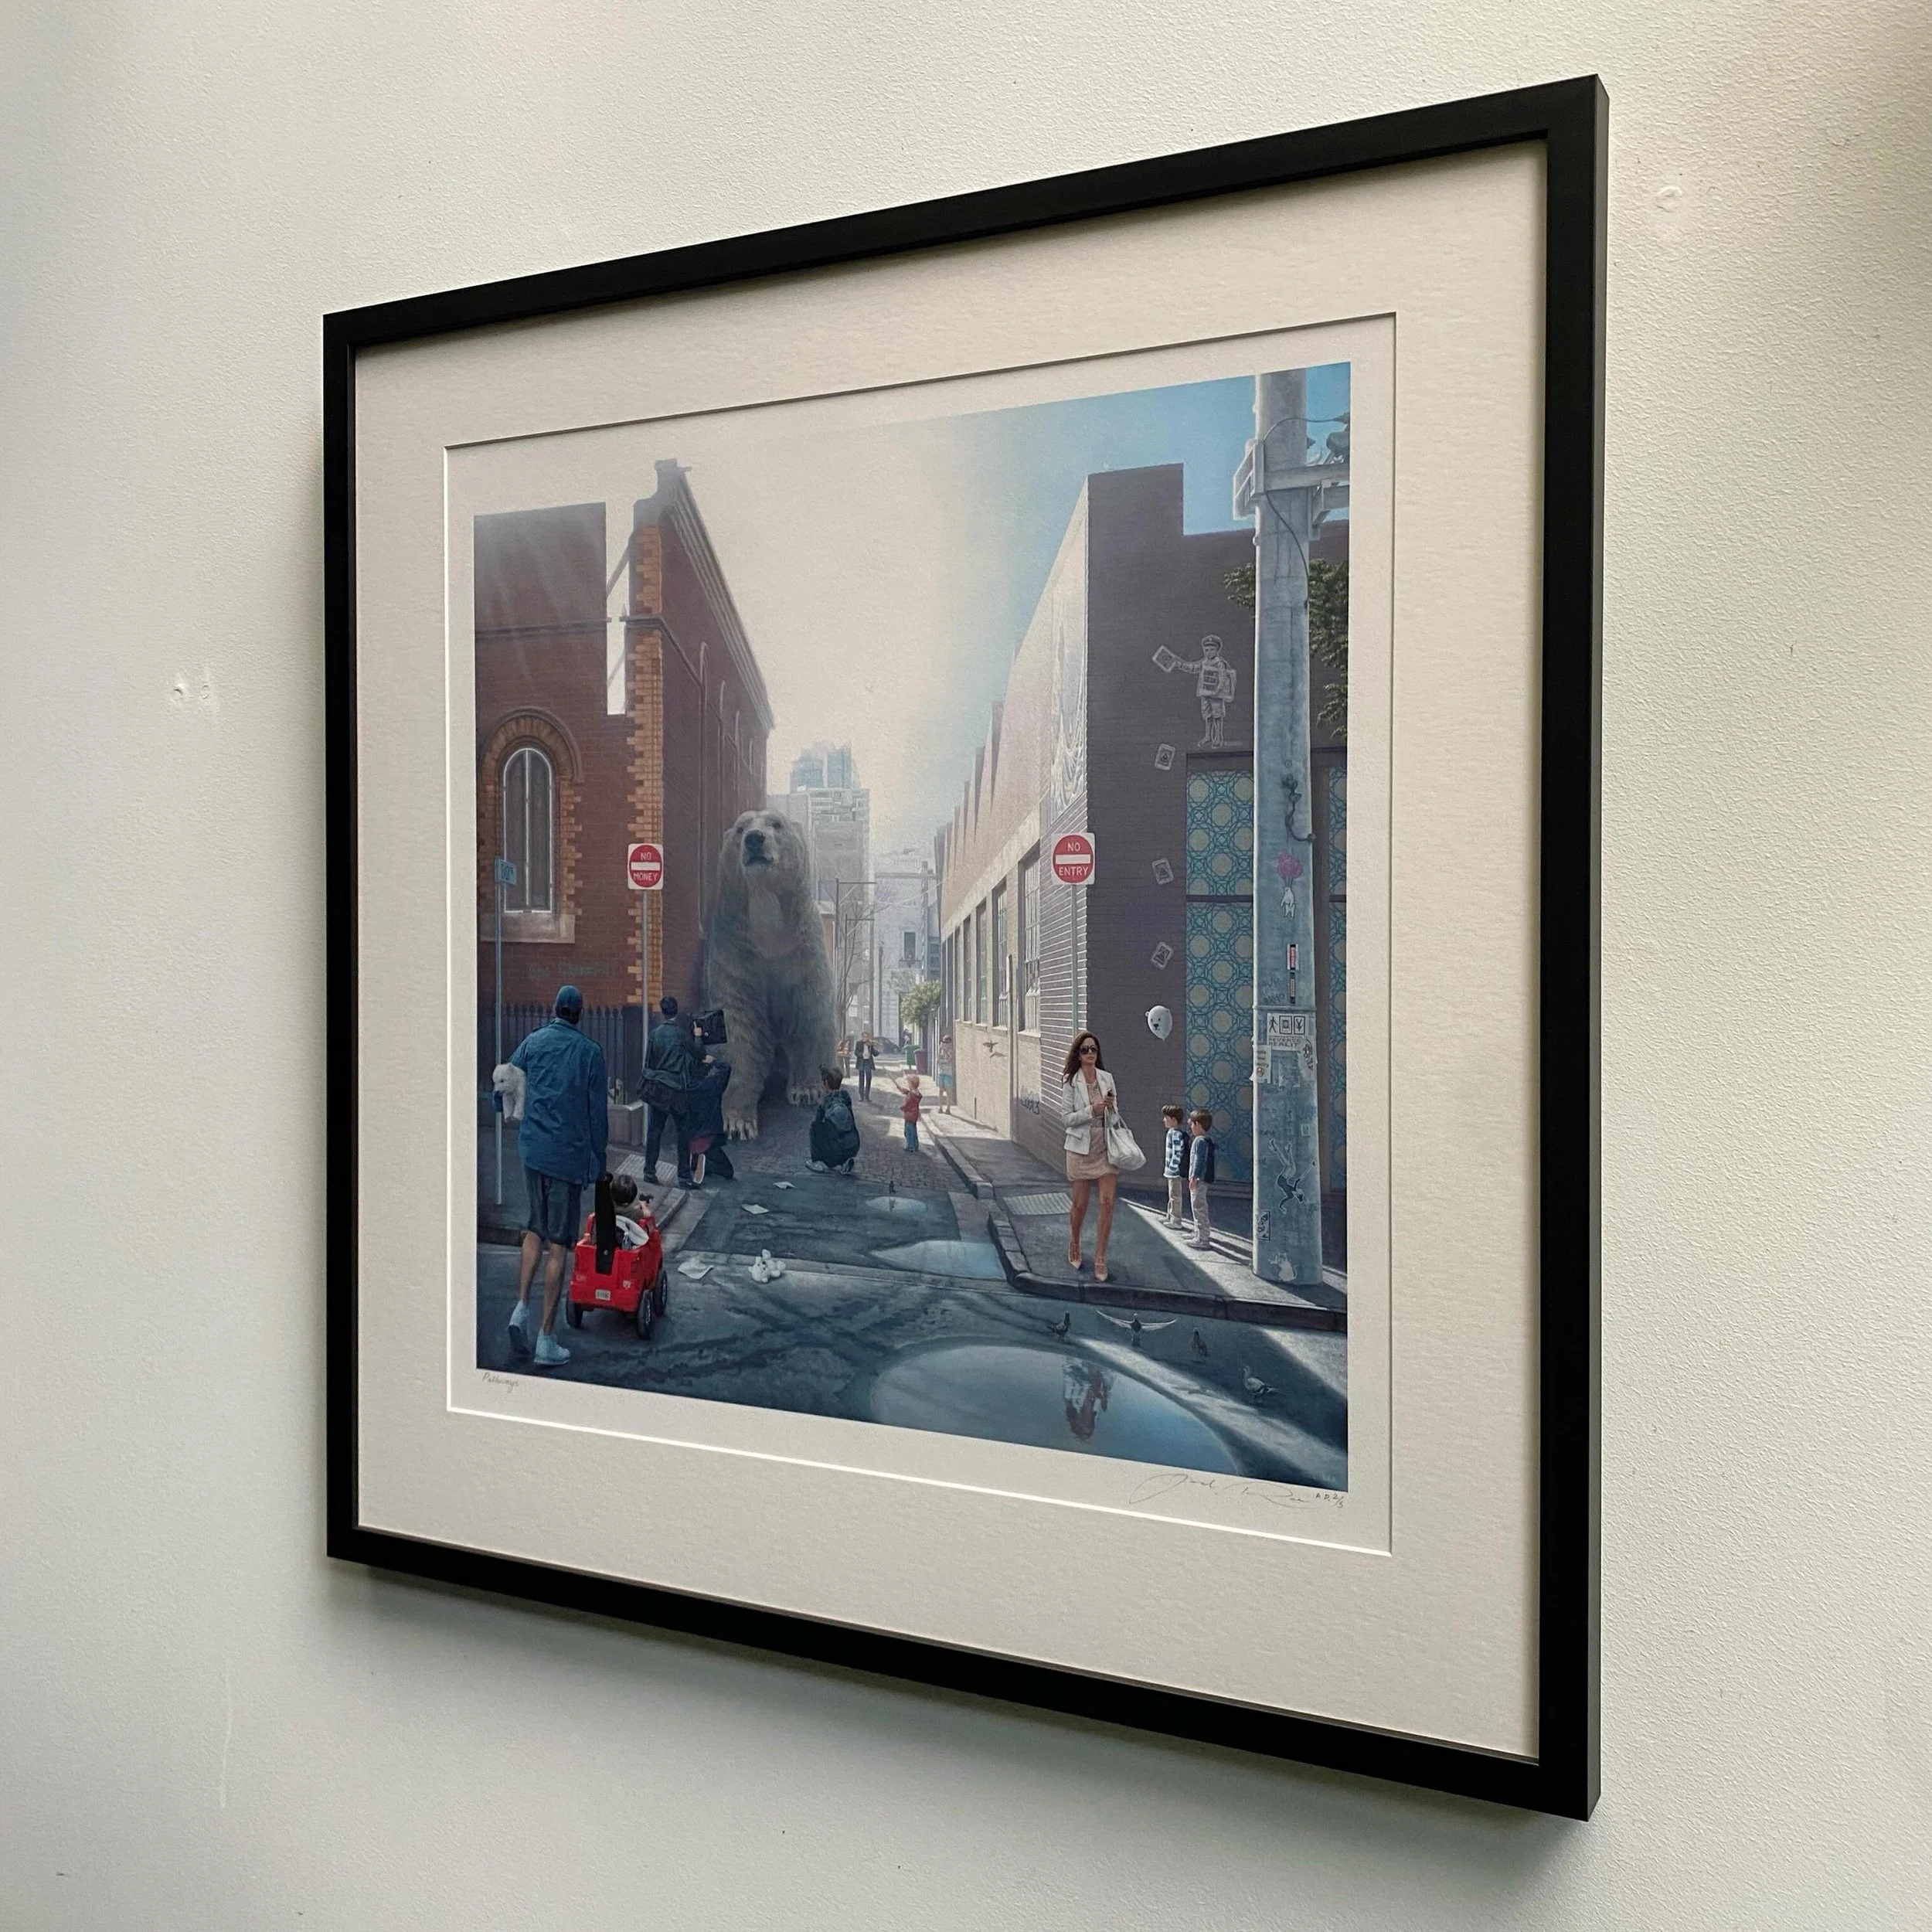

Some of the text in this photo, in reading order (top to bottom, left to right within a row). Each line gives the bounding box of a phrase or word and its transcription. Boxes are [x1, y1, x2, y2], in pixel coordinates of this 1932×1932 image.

[1067, 842, 1081, 852] NO
[640, 852, 651, 861] NO
[1059, 866, 1088, 876] ENTRY
[633, 872, 658, 881] MONEY
